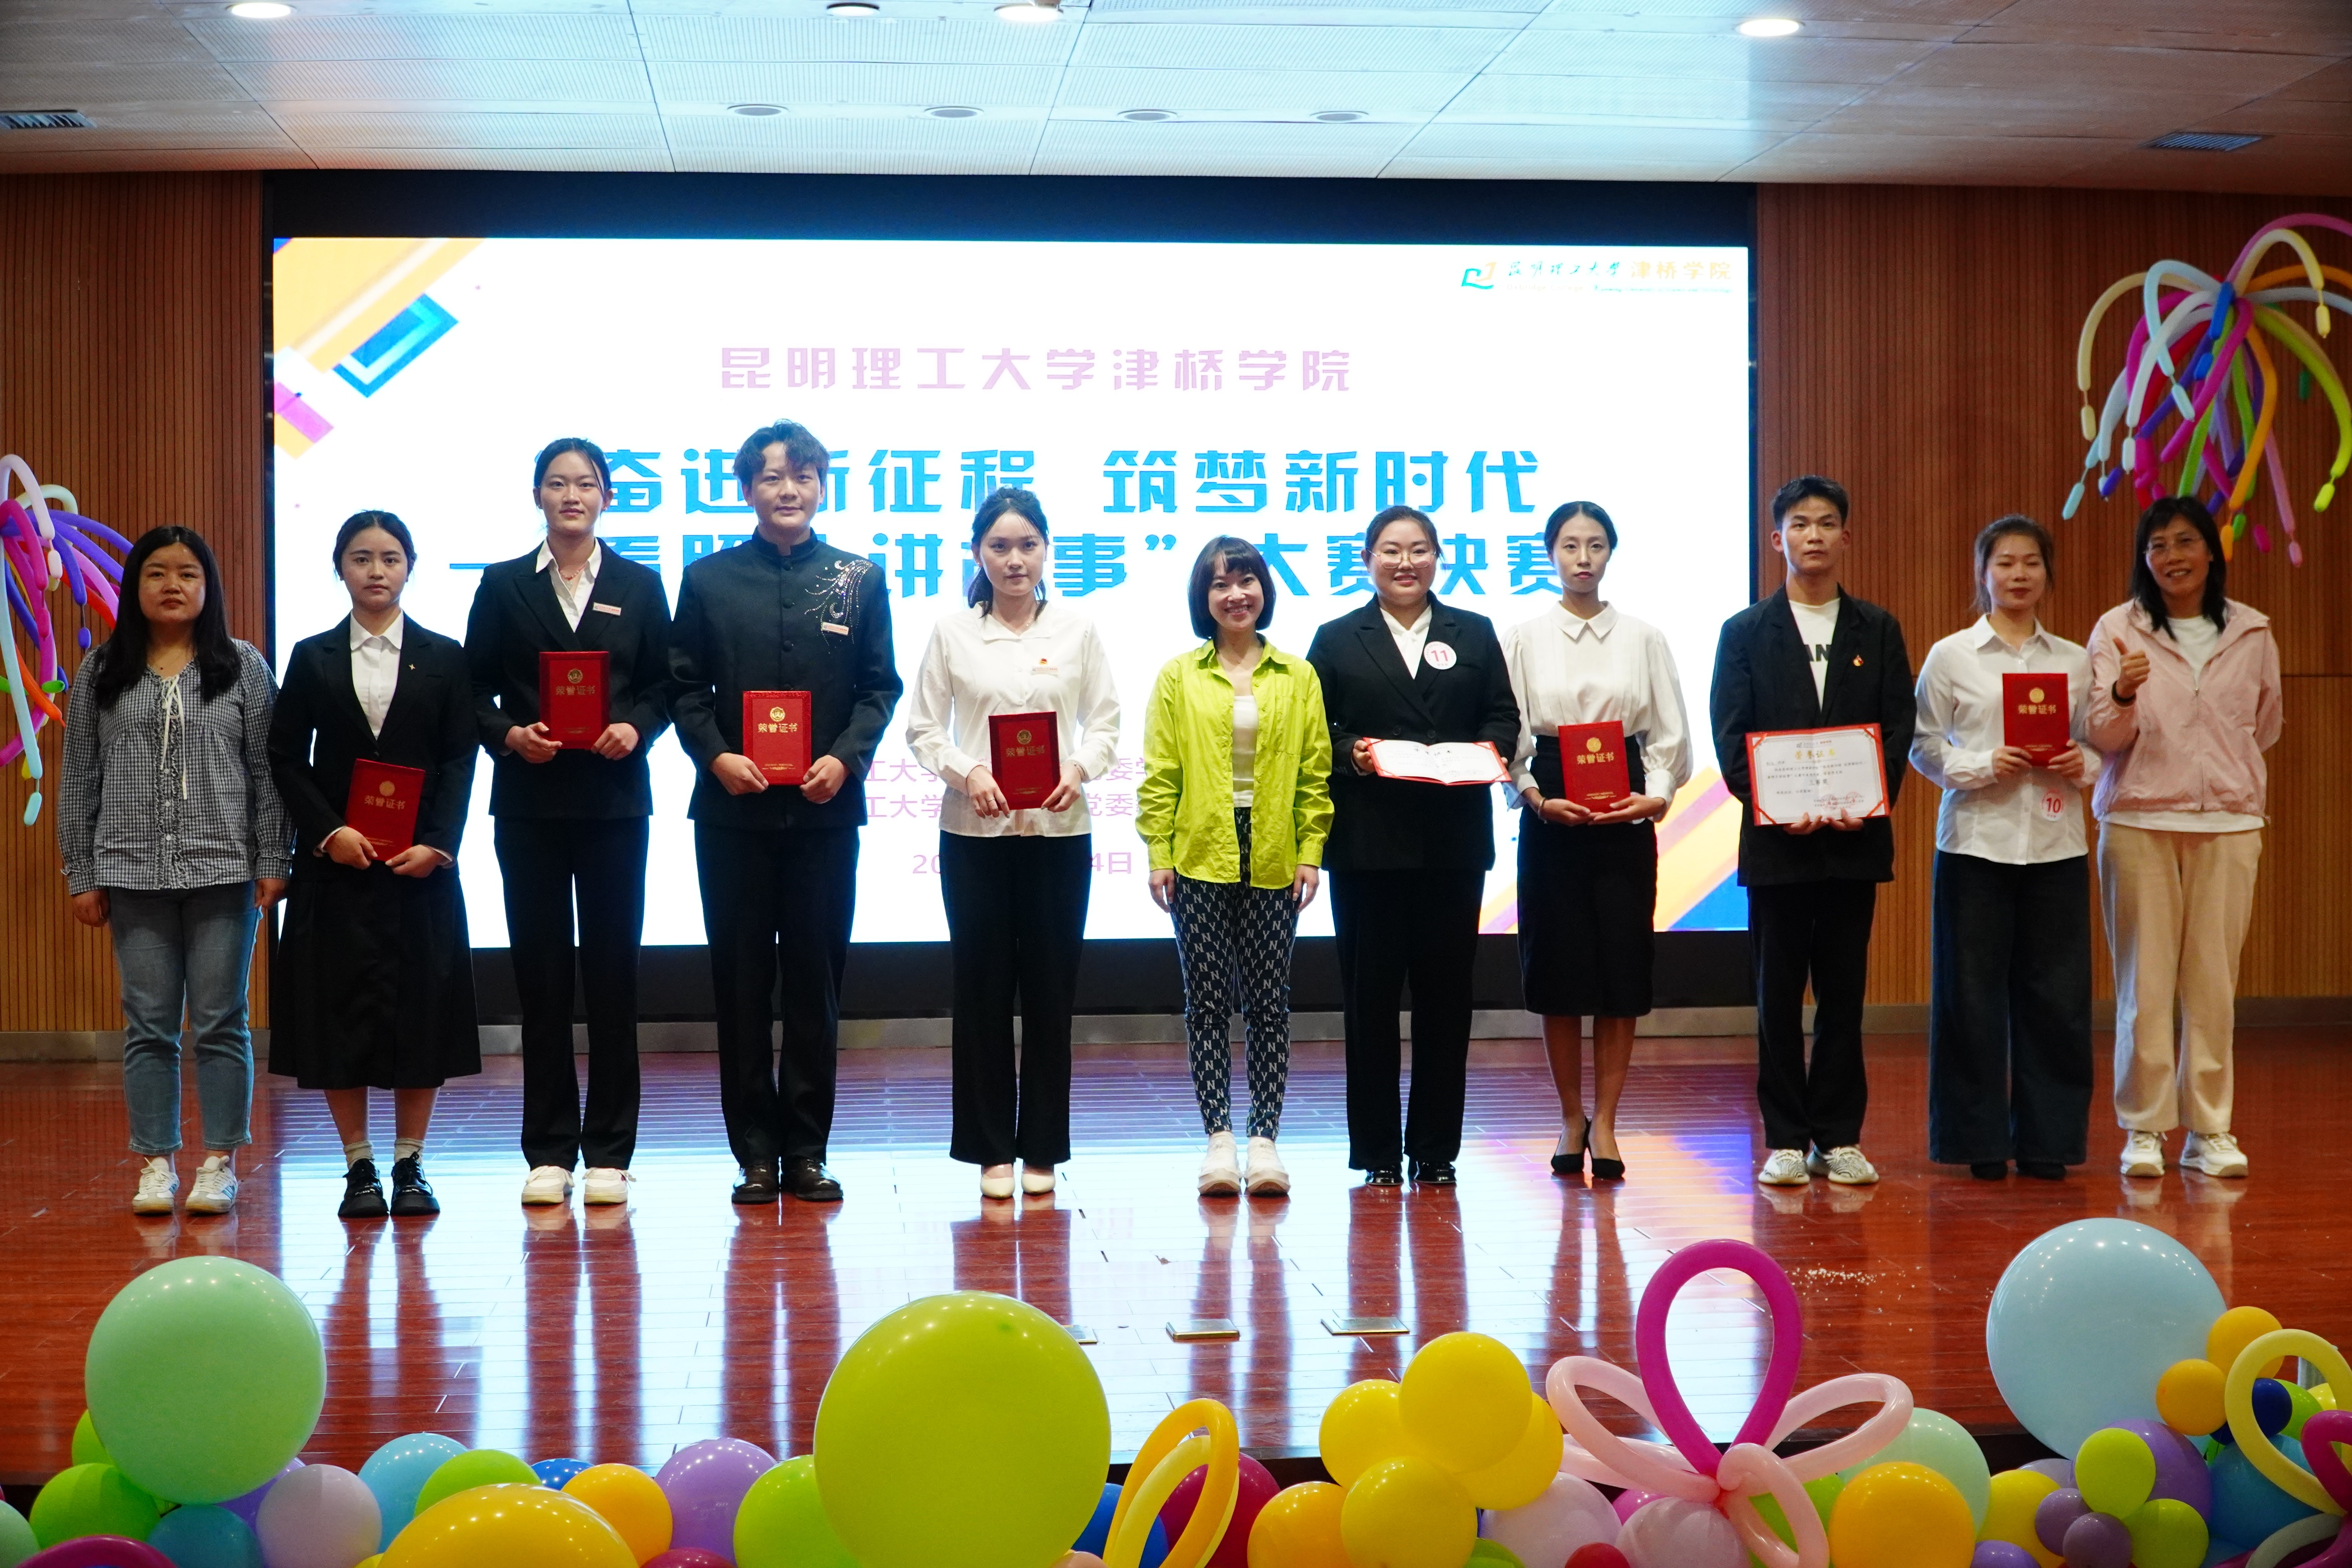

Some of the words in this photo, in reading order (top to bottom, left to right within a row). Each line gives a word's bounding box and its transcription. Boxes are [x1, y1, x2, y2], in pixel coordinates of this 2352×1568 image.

[721, 348, 1350, 391] 昆明理工大学津桥学院
[1103, 450, 1538, 514] 筑梦新时代
[1431, 650, 1448, 662] 11
[556, 686, 595, 696] 荣誉证书
[2018, 704, 2056, 715] 荣誉证书
[758, 723, 798, 733] 荣誉证书
[1006, 745, 1045, 757] 荣誉证书
[1577, 752, 1614, 764] 荣誉证书
[365, 795, 406, 811] 荣誉证书
[2047, 798, 2061, 813] 10
[1183, 884, 1191, 893] N
[1200, 884, 1206, 893] Y
[1177, 893, 1182, 903] Y
[1193, 894, 1202, 903] N
[1209, 892, 1215, 901] Y
[1252, 890, 1259, 899] N
[1269, 891, 1274, 900] Y
[1186, 904, 1194, 913] N
[1204, 903, 1211, 912] Y
[1218, 900, 1226, 910] N
[1243, 899, 1250, 909] N
[1260, 901, 1267, 910] Y
[1275, 900, 1283, 910] N
[1180, 913, 1186, 923] Y
[1197, 913, 1207, 923] N
[1214, 911, 1220, 920] Y
[1249, 910, 1257, 919] N
[1266, 911, 1272, 920] Y
[1283, 909, 1290, 919] N
[1190, 924, 1199, 933] N
[1209, 922, 1215, 931] Y
[1223, 919, 1229, 929] N
[1257, 920, 1264, 929] Y
[1272, 920, 1281, 930] N
[1185, 933, 1190, 942] Y
[1201, 933, 1211, 942] N
[1218, 930, 1224, 939] Y
[1247, 929, 1254, 938] N
[1263, 931, 1270, 940] Y
[1280, 929, 1287, 939] N
[1194, 943, 1204, 953] N
[1213, 941, 1220, 950] Y
[1226, 937, 1232, 947] N
[1254, 940, 1261, 949] Y
[1269, 940, 1278, 950] N
[1286, 938, 1291, 947] Y
[1189, 953, 1194, 962] Y
[1206, 952, 1216, 961] N
[1222, 947, 1227, 956] Y
[1245, 947, 1251, 957] N
[1259, 950, 1266, 959] Y
[1276, 949, 1283, 959] N
[1199, 963, 1208, 971] N
[1217, 959, 1223, 968] Y
[1225, 965, 1229, 974] Y
[1251, 959, 1257, 968] Y
[1265, 960, 1274, 969] N
[1193, 972, 1199, 980] Y
[1210, 970, 1220, 980] N
[1243, 966, 1248, 976] N
[1256, 969, 1263, 978] Y
[1273, 968, 1280, 978] N
[1190, 980, 1195, 989] Y
[1203, 981, 1212, 991] N
[1221, 977, 1226, 987] Y
[1249, 977, 1254, 987] Y
[1263, 979, 1271, 989] N
[1280, 976, 1285, 985] Y
[1196, 991, 1203, 1000] Y
[1214, 989, 1221, 999] N
[1255, 989, 1261, 998] Y
[1273, 987, 1279, 998] N
[1196, 1031, 1202, 1040] Y
[1213, 1030, 1219, 1039] N
[1260, 1033, 1265, 1041] Y
[1277, 1033, 1284, 1042] N
[1190, 1042, 1195, 1051] Y
[1203, 1040, 1212, 1050] N
[1220, 1039, 1225, 1048] Y
[1255, 1042, 1259, 1051] Y
[1268, 1042, 1276, 1052] N
[1196, 1051, 1202, 1061] Y
[1214, 1049, 1221, 1059] N
[1249, 1051, 1254, 1060] N
[1260, 1052, 1266, 1061] Y
[1278, 1053, 1285, 1062] N
[1192, 1062, 1196, 1071] Y
[1205, 1060, 1214, 1070] N
[1222, 1058, 1227, 1068] Y
[1255, 1062, 1261, 1071] Y
[1269, 1062, 1277, 1072] N
[1198, 1071, 1204, 1080] Y
[1216, 1069, 1222, 1079] N
[1261, 1072, 1267, 1081] Y
[1278, 1073, 1285, 1082] N
[1207, 1080, 1215, 1090] N
[1223, 1078, 1228, 1087] Y
[1256, 1081, 1261, 1091] Y
[1269, 1083, 1276, 1092] N
[1200, 1091, 1206, 1100] Y
[1217, 1089, 1224, 1098] N
[1261, 1091, 1267, 1101] Y
[1277, 1093, 1283, 1102] N
[1203, 1109, 1209, 1118] Y
[1220, 1106, 1227, 1115] N
[1267, 1102, 1275, 1112] N
[1266, 1119, 1272, 1129] N
[1257, 1127, 1263, 1136] Y
